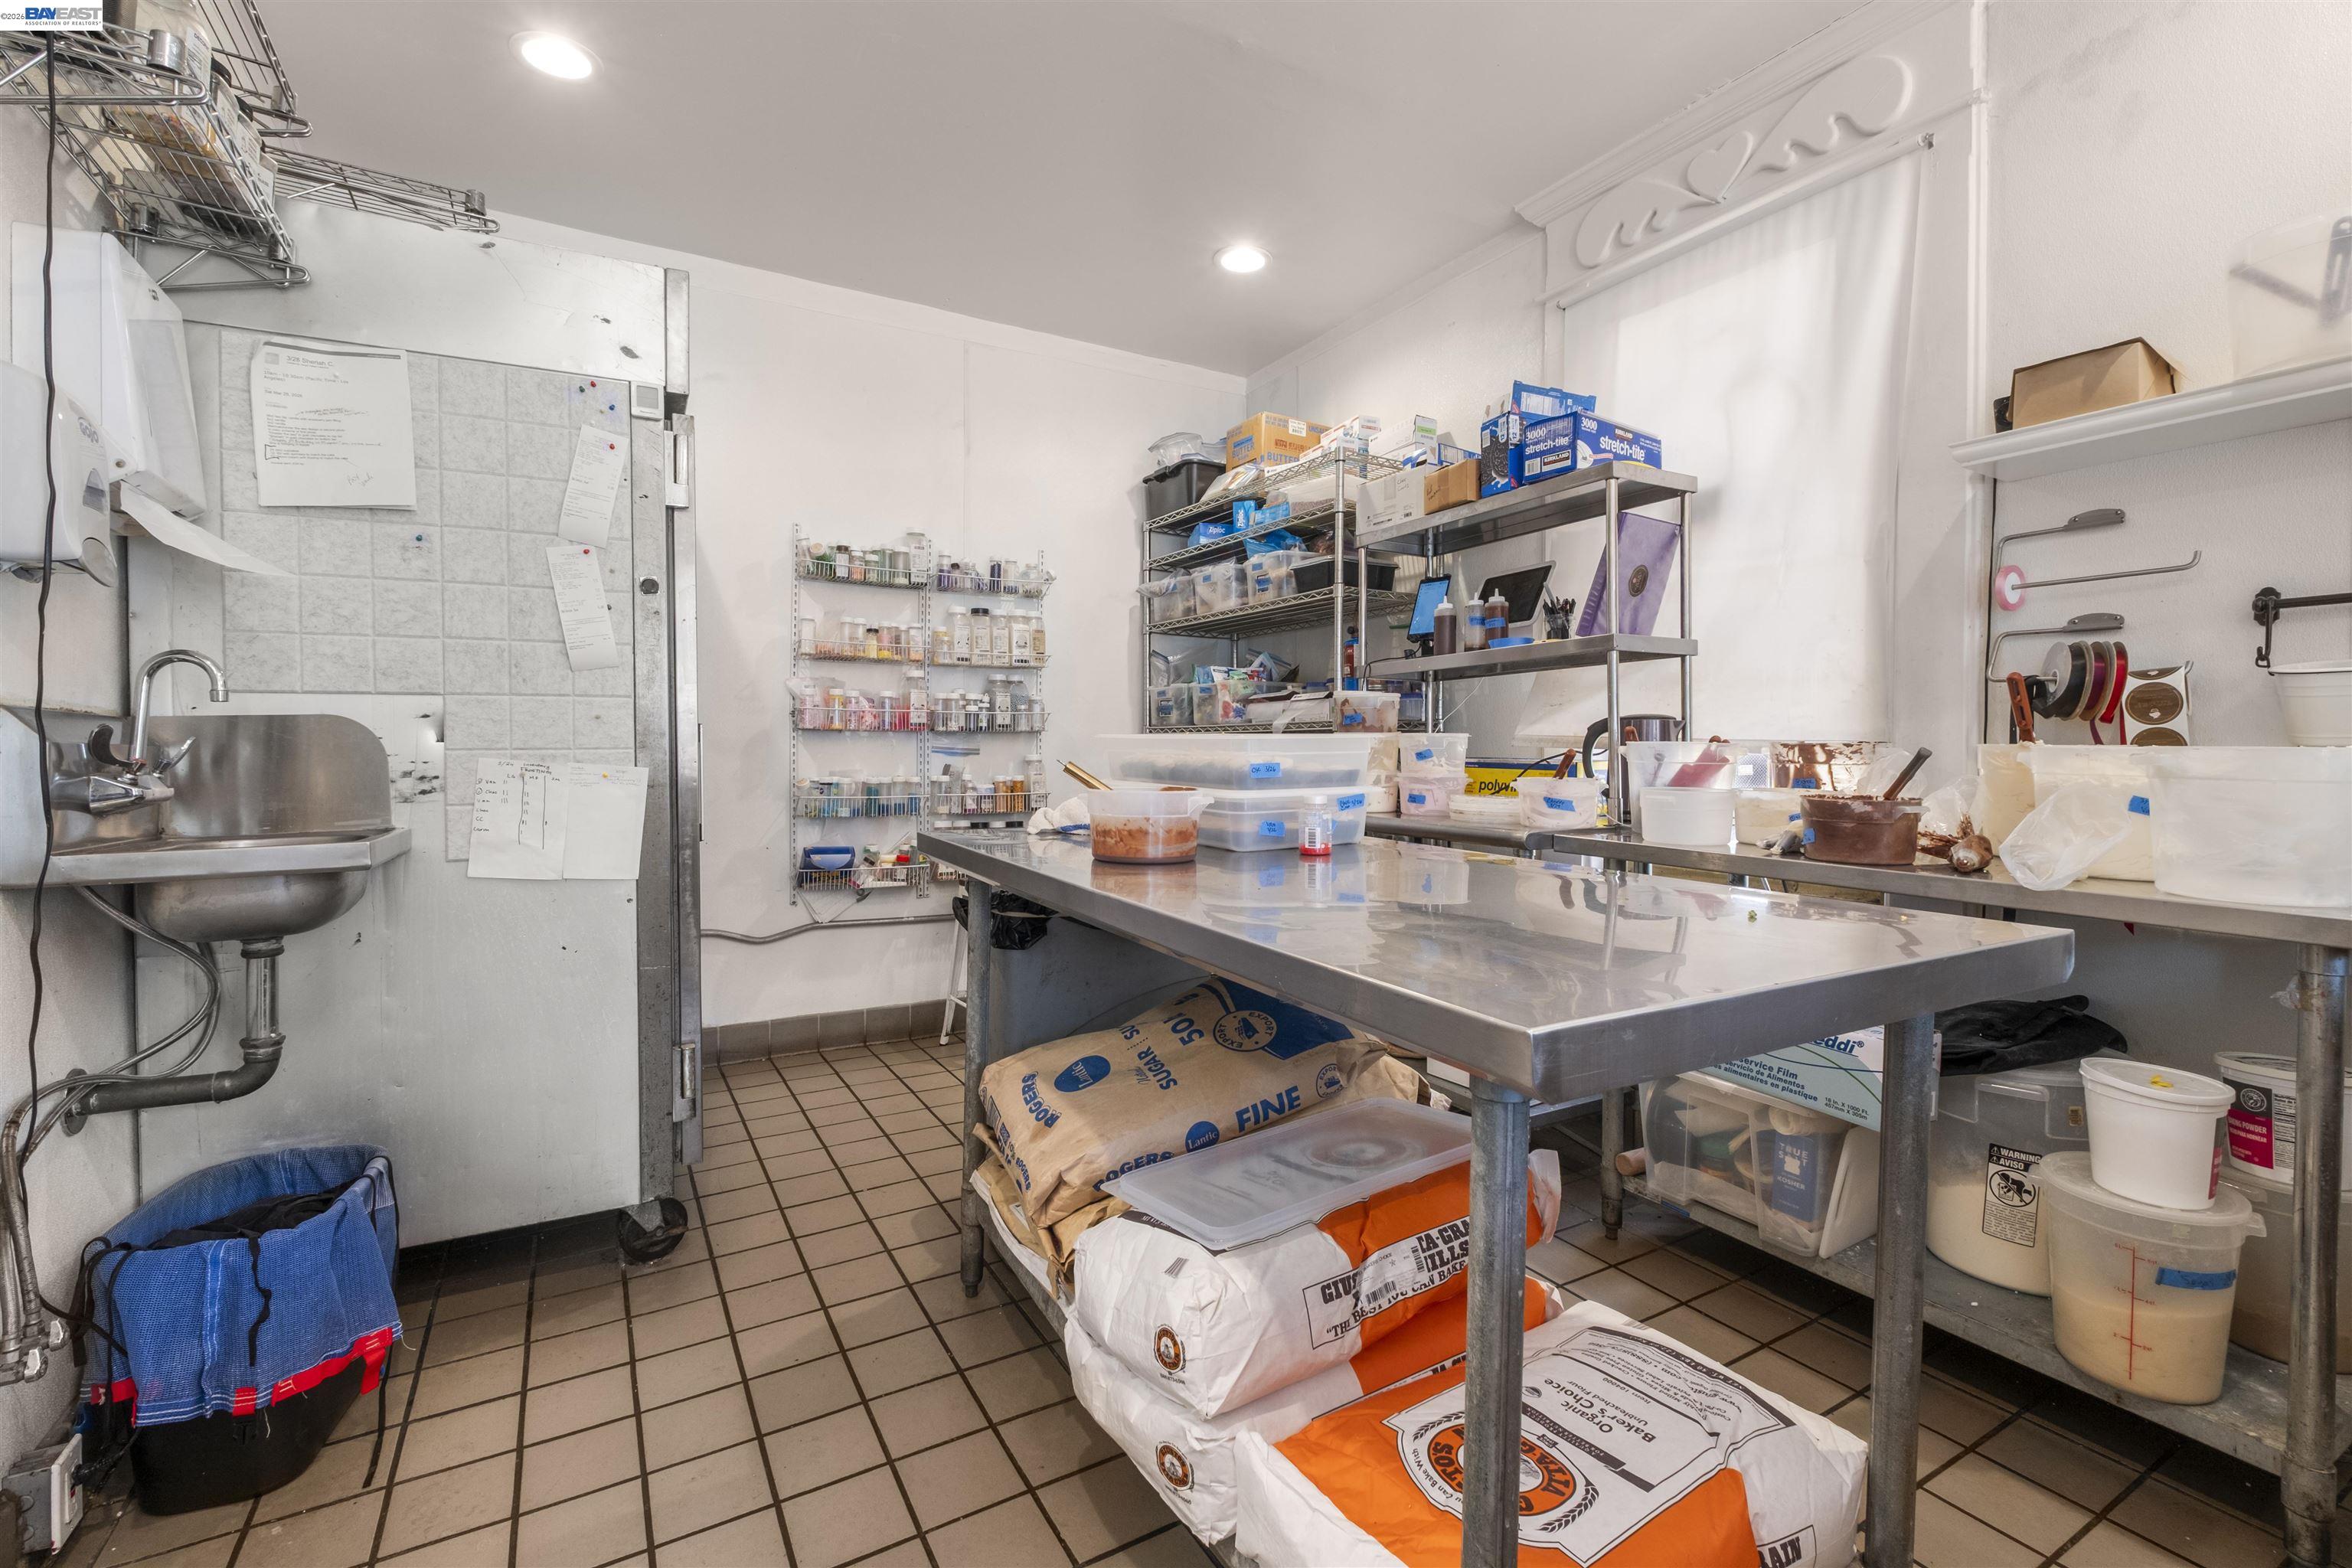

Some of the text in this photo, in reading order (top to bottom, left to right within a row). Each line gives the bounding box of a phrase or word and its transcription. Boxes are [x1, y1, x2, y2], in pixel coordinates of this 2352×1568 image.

[1525, 427, 1547, 442] 3000
[1581, 416, 1598, 431] 3000
[1525, 436, 1569, 455] stretch-tite
[1544, 452, 1570, 462] KIRKLAND
[1599, 436, 1645, 461] stretch-tite
[1478, 779, 1516, 792] polyv
[1217, 1024, 1243, 1049] EXPORT
[1248, 1011, 1275, 1037] EXPORT
[1813, 1036, 1864, 1054] eddi®
[1072, 1061, 1093, 1088] Lantic
[1136, 1046, 1178, 1090] SUGAR
[1319, 1067, 1340, 1080] EXPOR
[1725, 1062, 1754, 1074] ervicio
[1766, 1073, 1805, 1090] Alimentos
[1739, 1057, 1798, 1080] service Film
[1723, 1067, 1768, 1086] alimentaires
[1782, 1084, 1818, 1102] plastique
[1021, 1071, 1062, 1128] ROGERS
[1236, 1086, 1301, 1133] FINE
[1847, 1104, 1860, 1112] 1000
[1187, 1129, 1218, 1149] Lantic
[2243, 1121, 2267, 1134] POWDER
[1779, 1151, 1808, 1167] ST
[1999, 1158, 2024, 1170] AVISO
[2000, 1148, 2041, 1163] WARNING
[1015, 1157, 1031, 1191] ROGERS
[1777, 1176, 1805, 1190] KOSHER
[1423, 1239, 1469, 1273] ILLS
[1566, 1380, 1648, 1426] Unbleached Flour
[1602, 1377, 1651, 1404] Item 104000
[1544, 1378, 1656, 1443] Baker's Choice
[1560, 1400, 1613, 1433] Organic
[1412, 1448, 1453, 1498] Can Bake With
